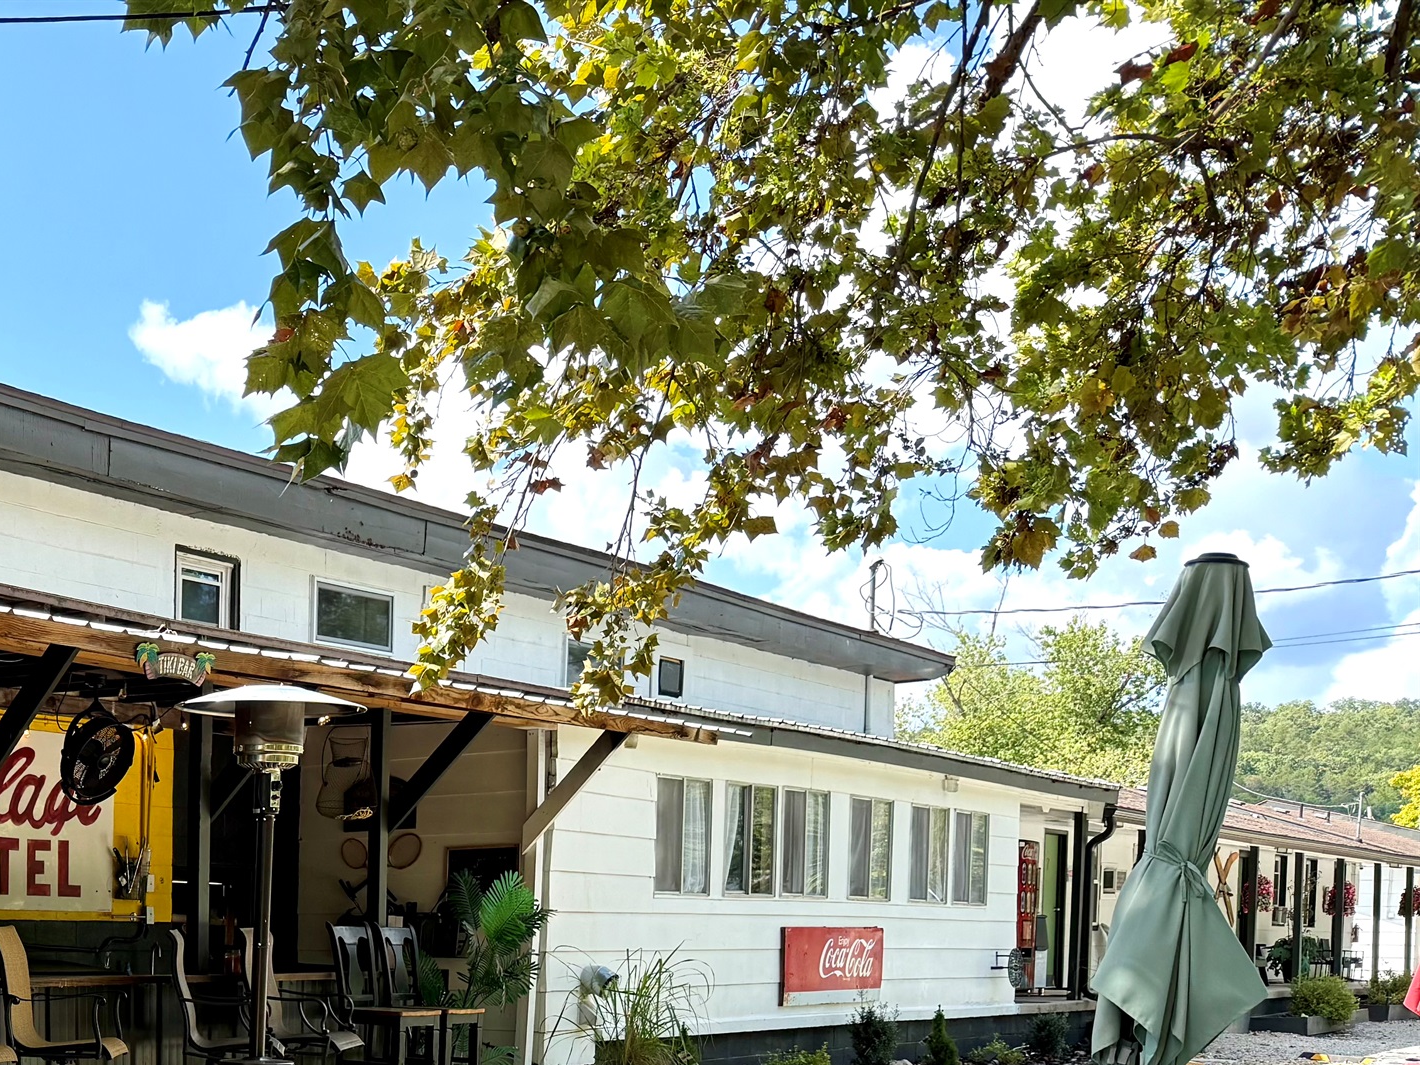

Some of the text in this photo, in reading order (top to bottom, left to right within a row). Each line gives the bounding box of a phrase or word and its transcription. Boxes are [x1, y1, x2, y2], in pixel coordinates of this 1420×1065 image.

[158, 656, 196, 680] TIKI BAR
[838, 935, 851, 947] Enjoy
